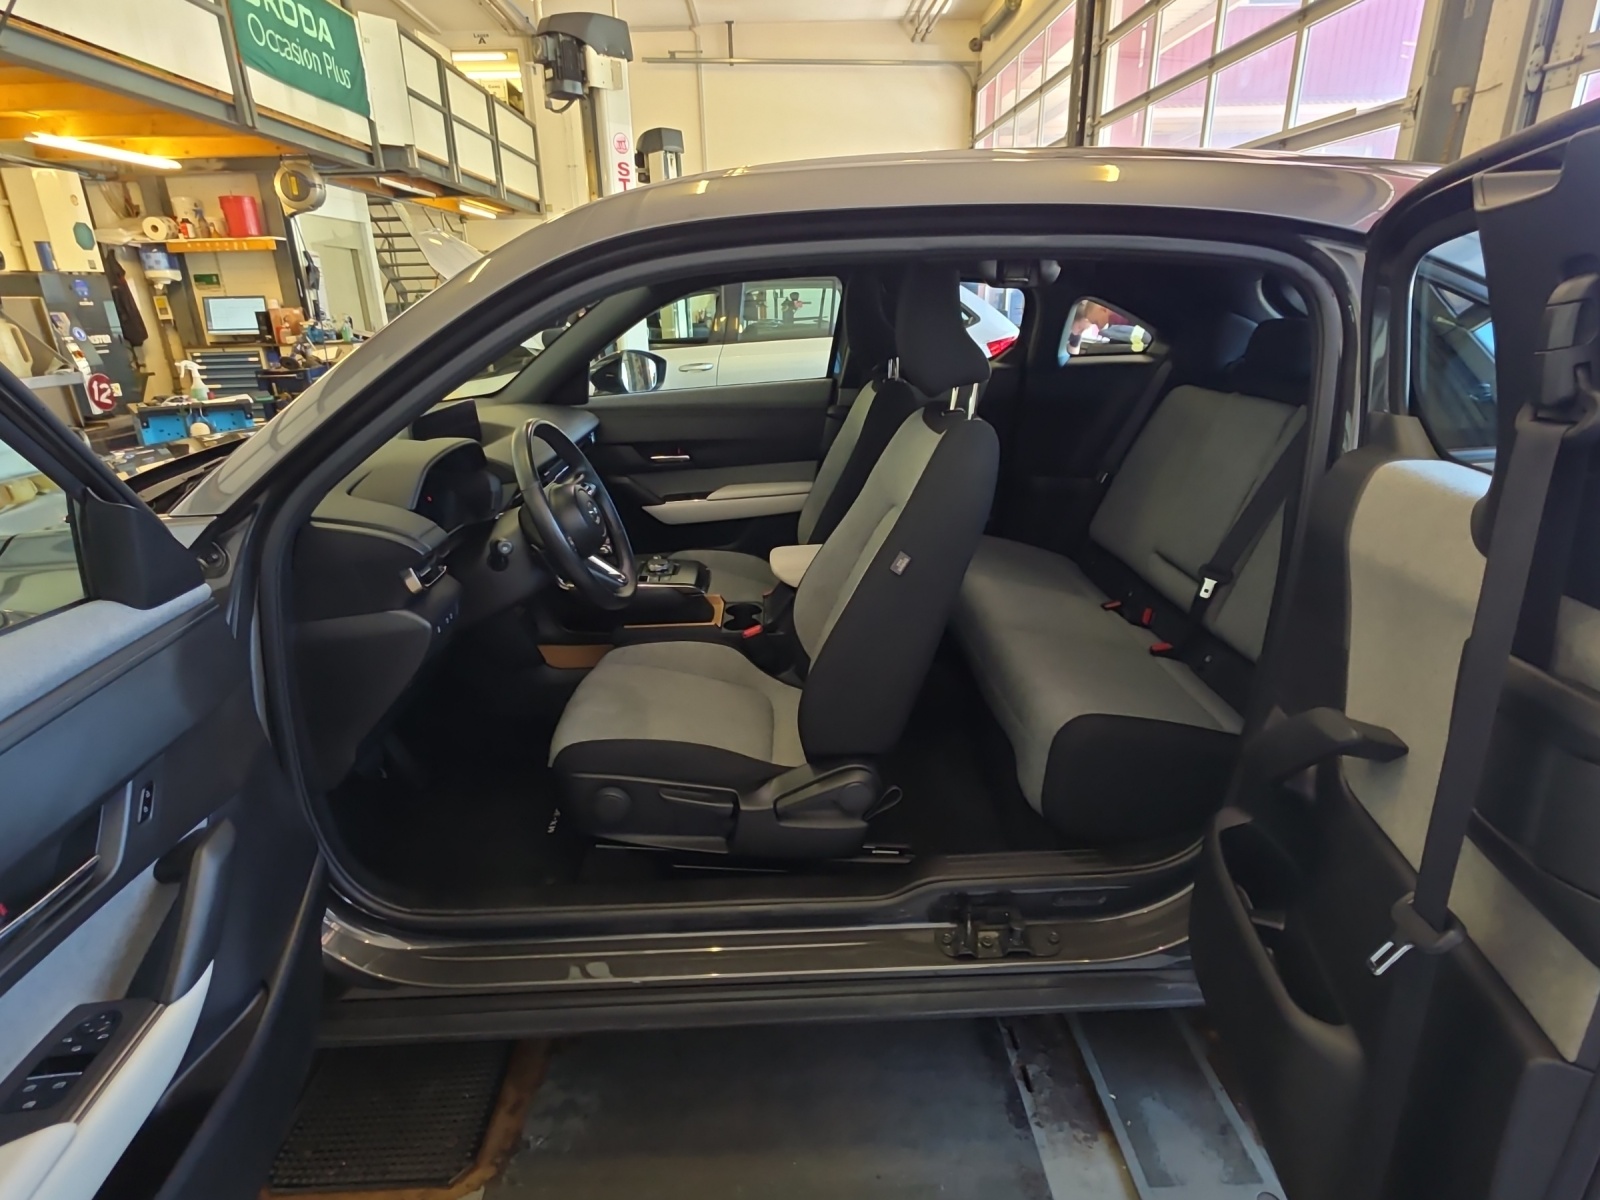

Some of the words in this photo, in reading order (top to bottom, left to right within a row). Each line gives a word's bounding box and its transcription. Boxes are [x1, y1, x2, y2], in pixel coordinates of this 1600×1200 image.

[244, 0, 336, 50] KODA
[247, 13, 322, 74] Occasion
[323, 51, 352, 89] Plus
[92, 380, 113, 405] 12
